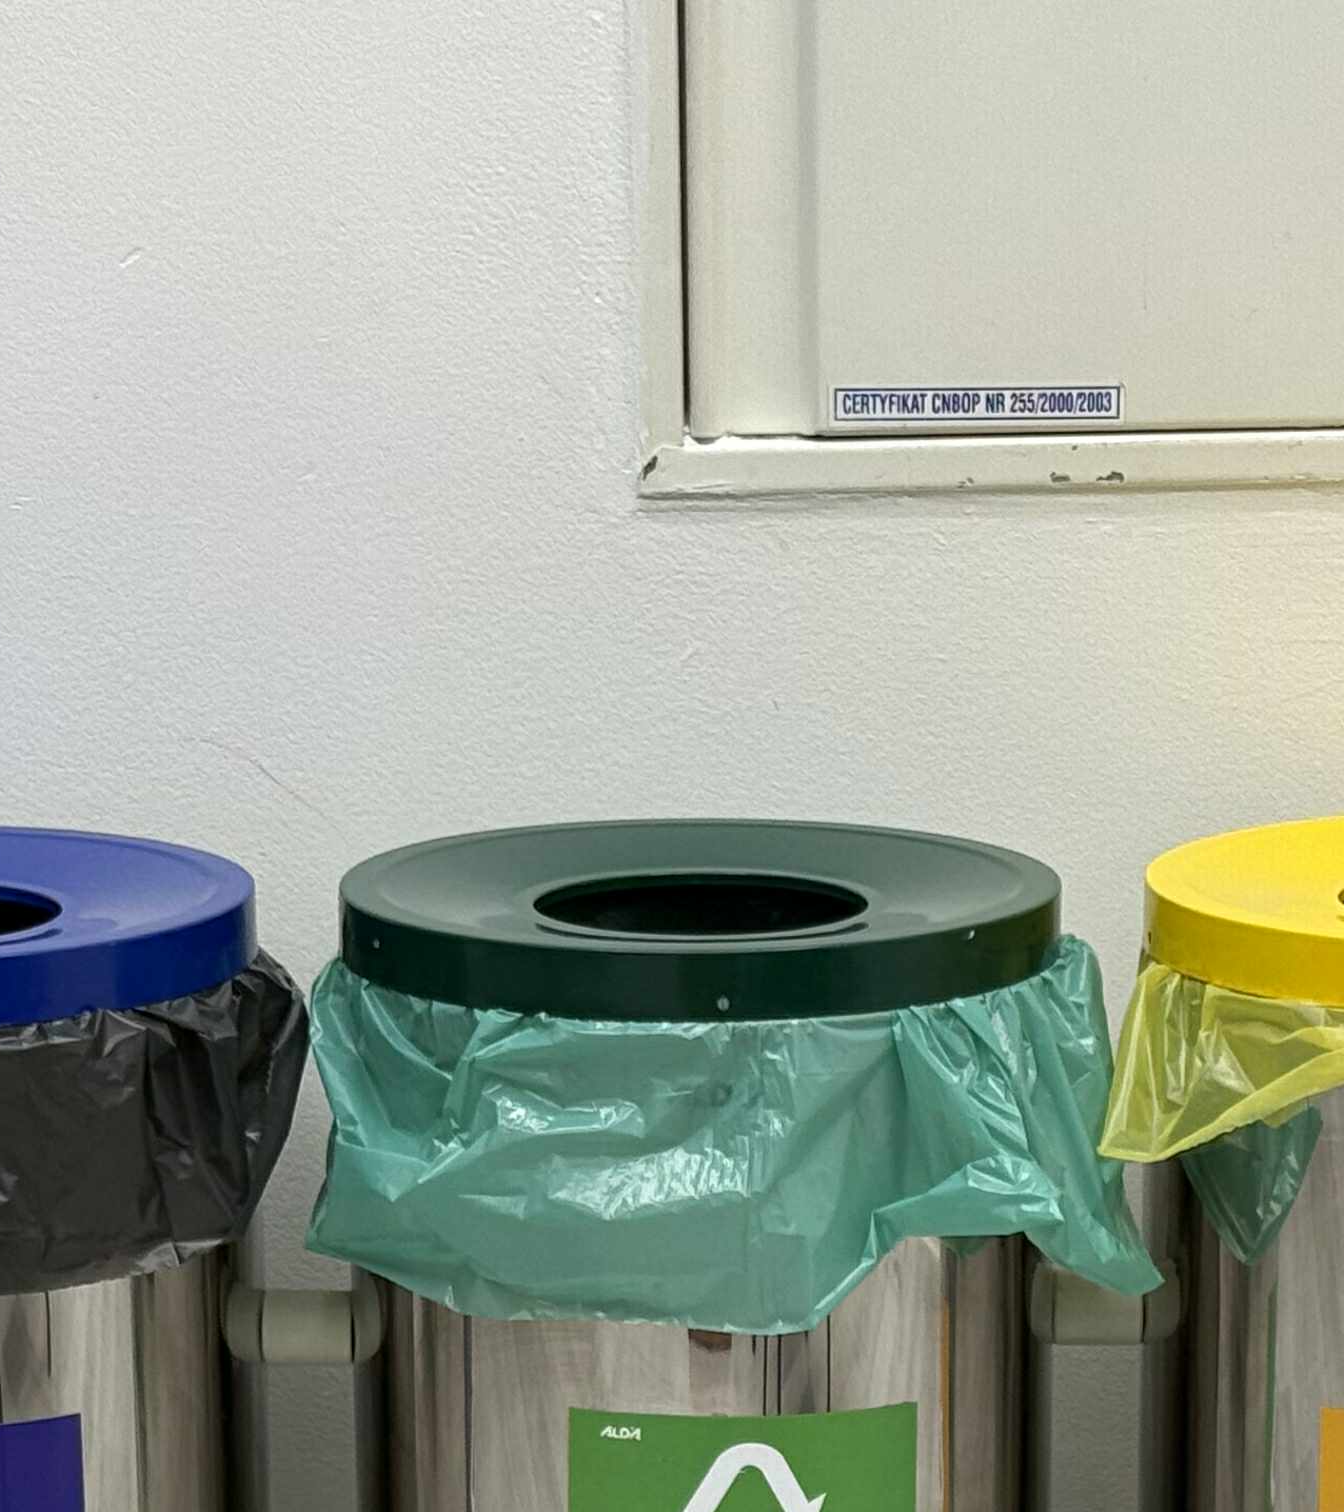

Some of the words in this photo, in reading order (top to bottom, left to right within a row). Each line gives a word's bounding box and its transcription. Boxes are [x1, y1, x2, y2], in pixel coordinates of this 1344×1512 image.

[842, 393, 928, 414] CERTYFIKAT
[931, 392, 981, 414] CNBOP
[985, 392, 1006, 413] NR
[1009, 391, 1112, 414] 255/2000/2003
[599, 1425, 641, 1441] ALDA
